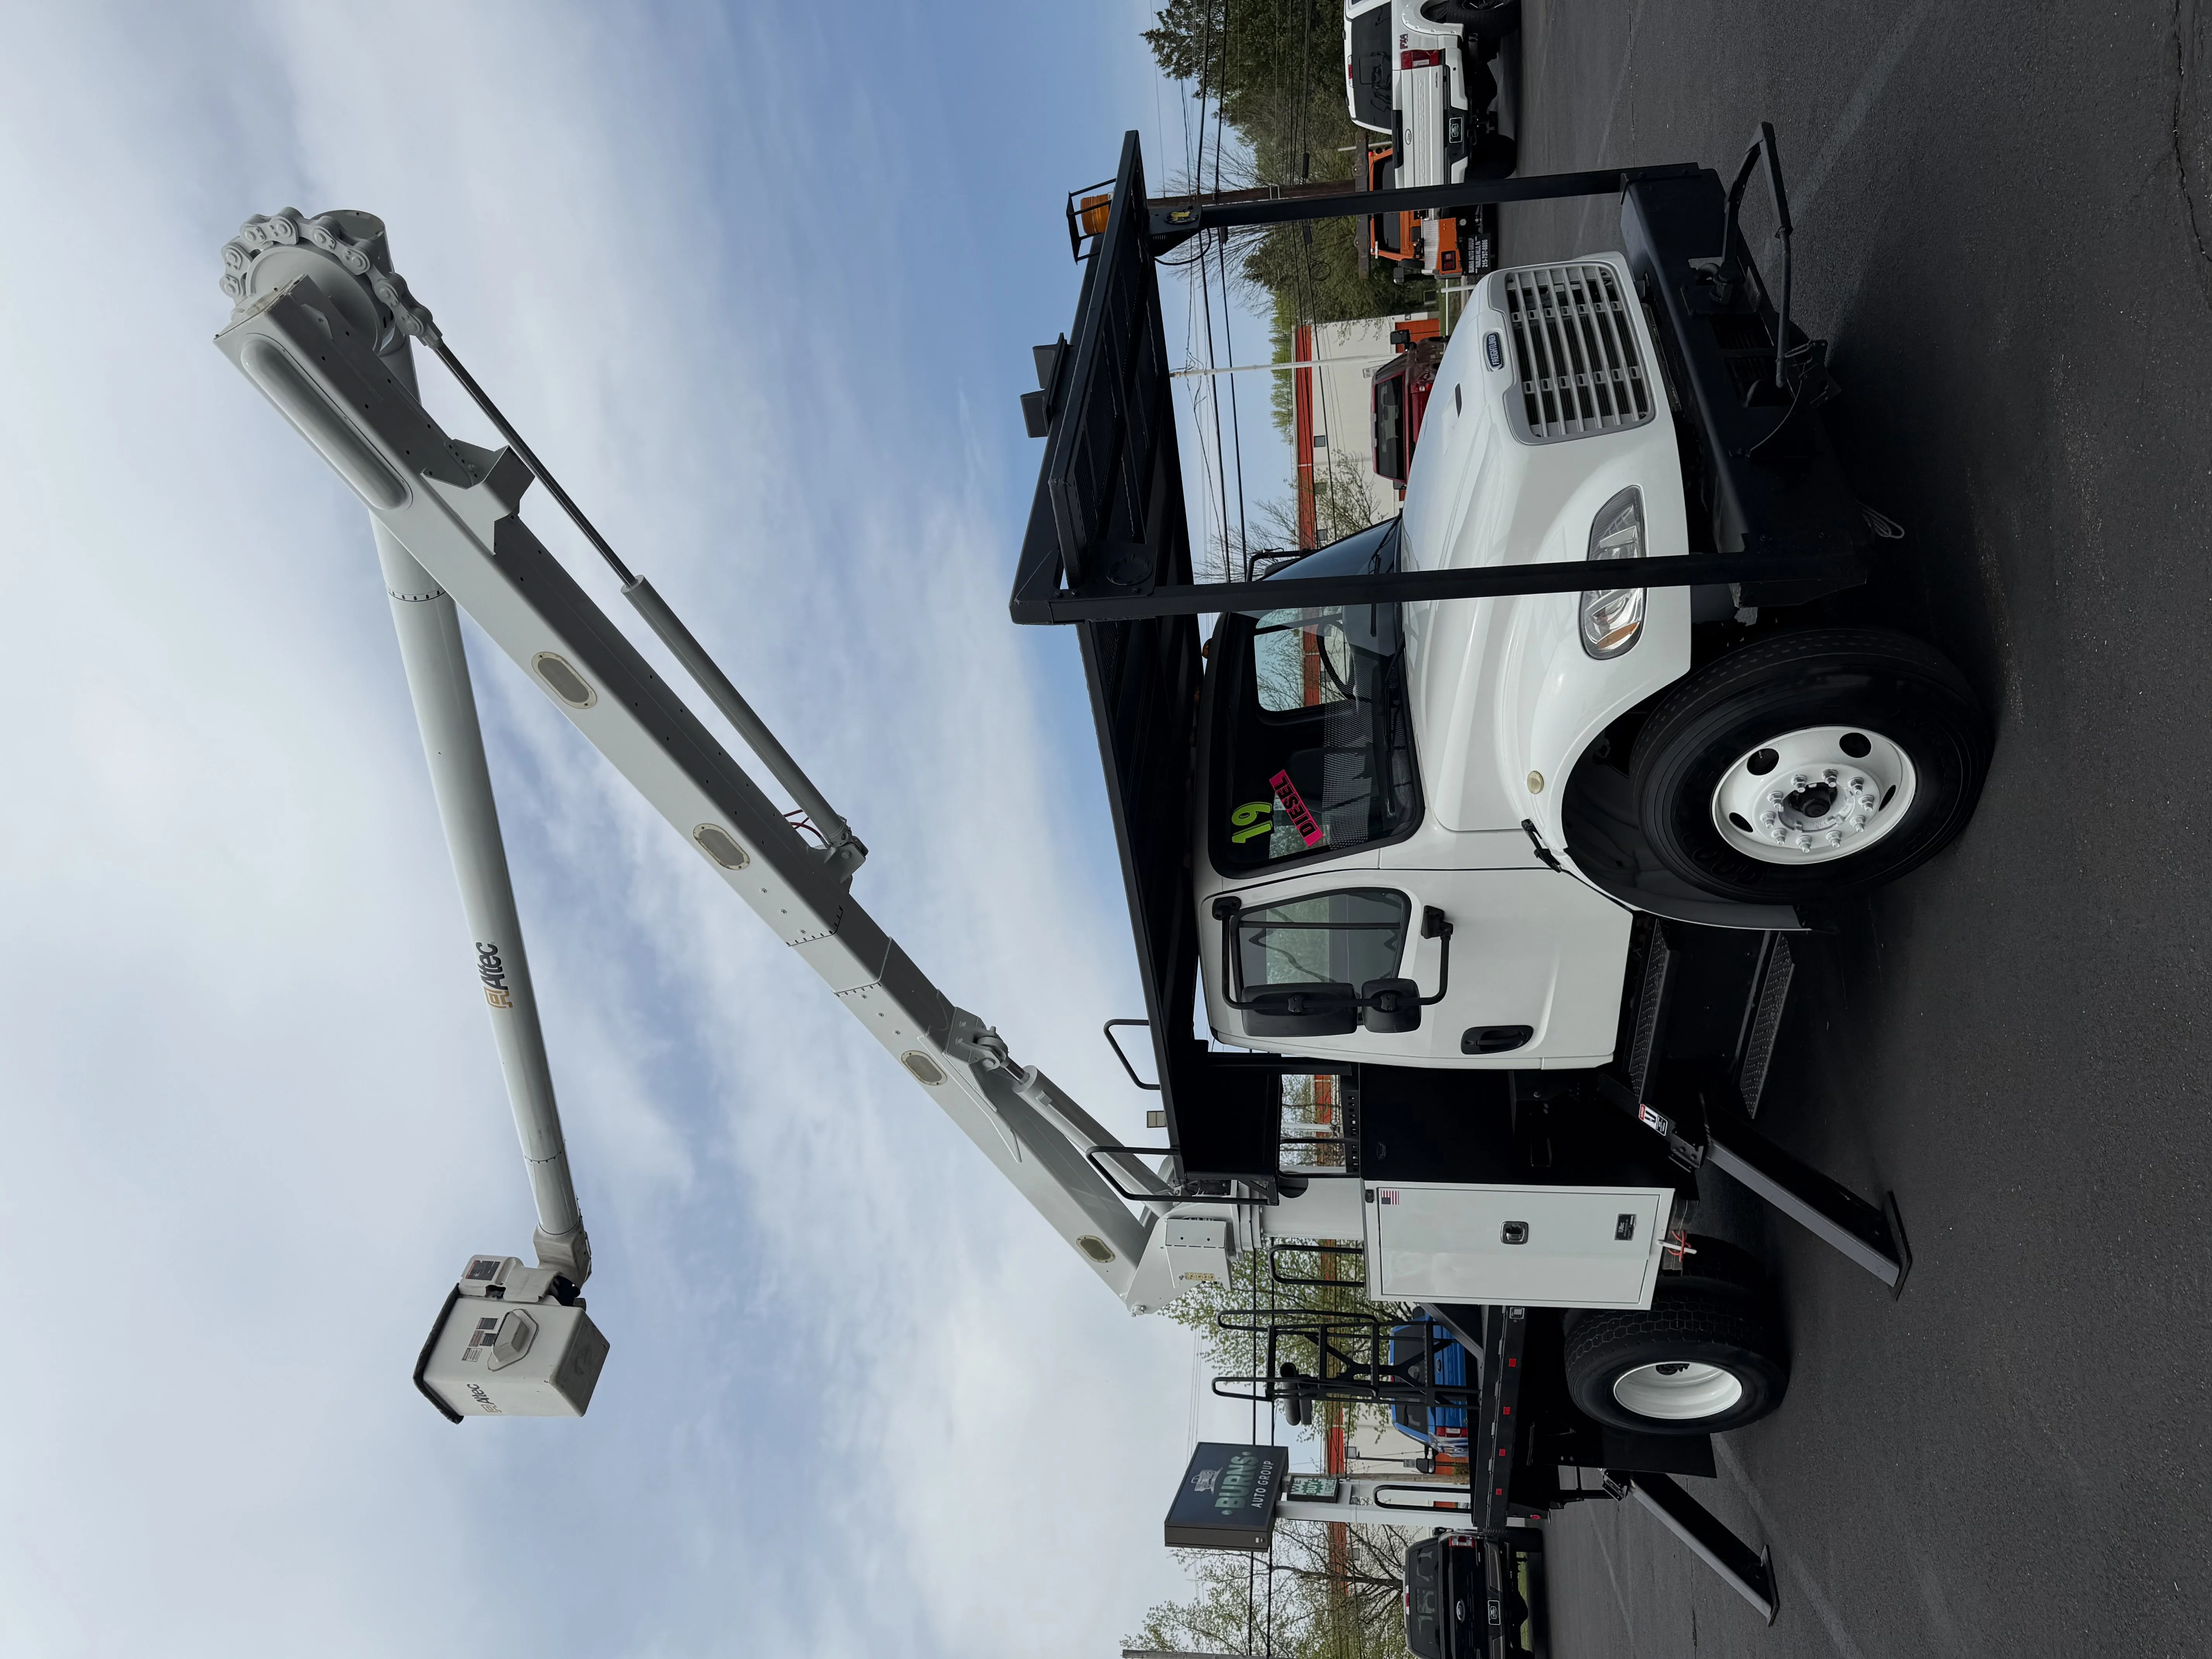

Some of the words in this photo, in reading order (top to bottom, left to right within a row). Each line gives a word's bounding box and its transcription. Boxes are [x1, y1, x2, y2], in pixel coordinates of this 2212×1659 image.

[1488, 334, 1500, 365] FREIGHTLINER
[1274, 773, 1317, 838] DIESEL
[1231, 802, 1273, 843] 19
[476, 942, 508, 990] Altec
[467, 1384, 494, 1405] Altec
[1215, 1456, 1259, 1508] BURNS
[1257, 1460, 1274, 1485] GROUP
[1290, 1480, 1301, 1493] WE
[1251, 1488, 1267, 1508] AUTO
[1306, 1481, 1318, 1494] BUY
